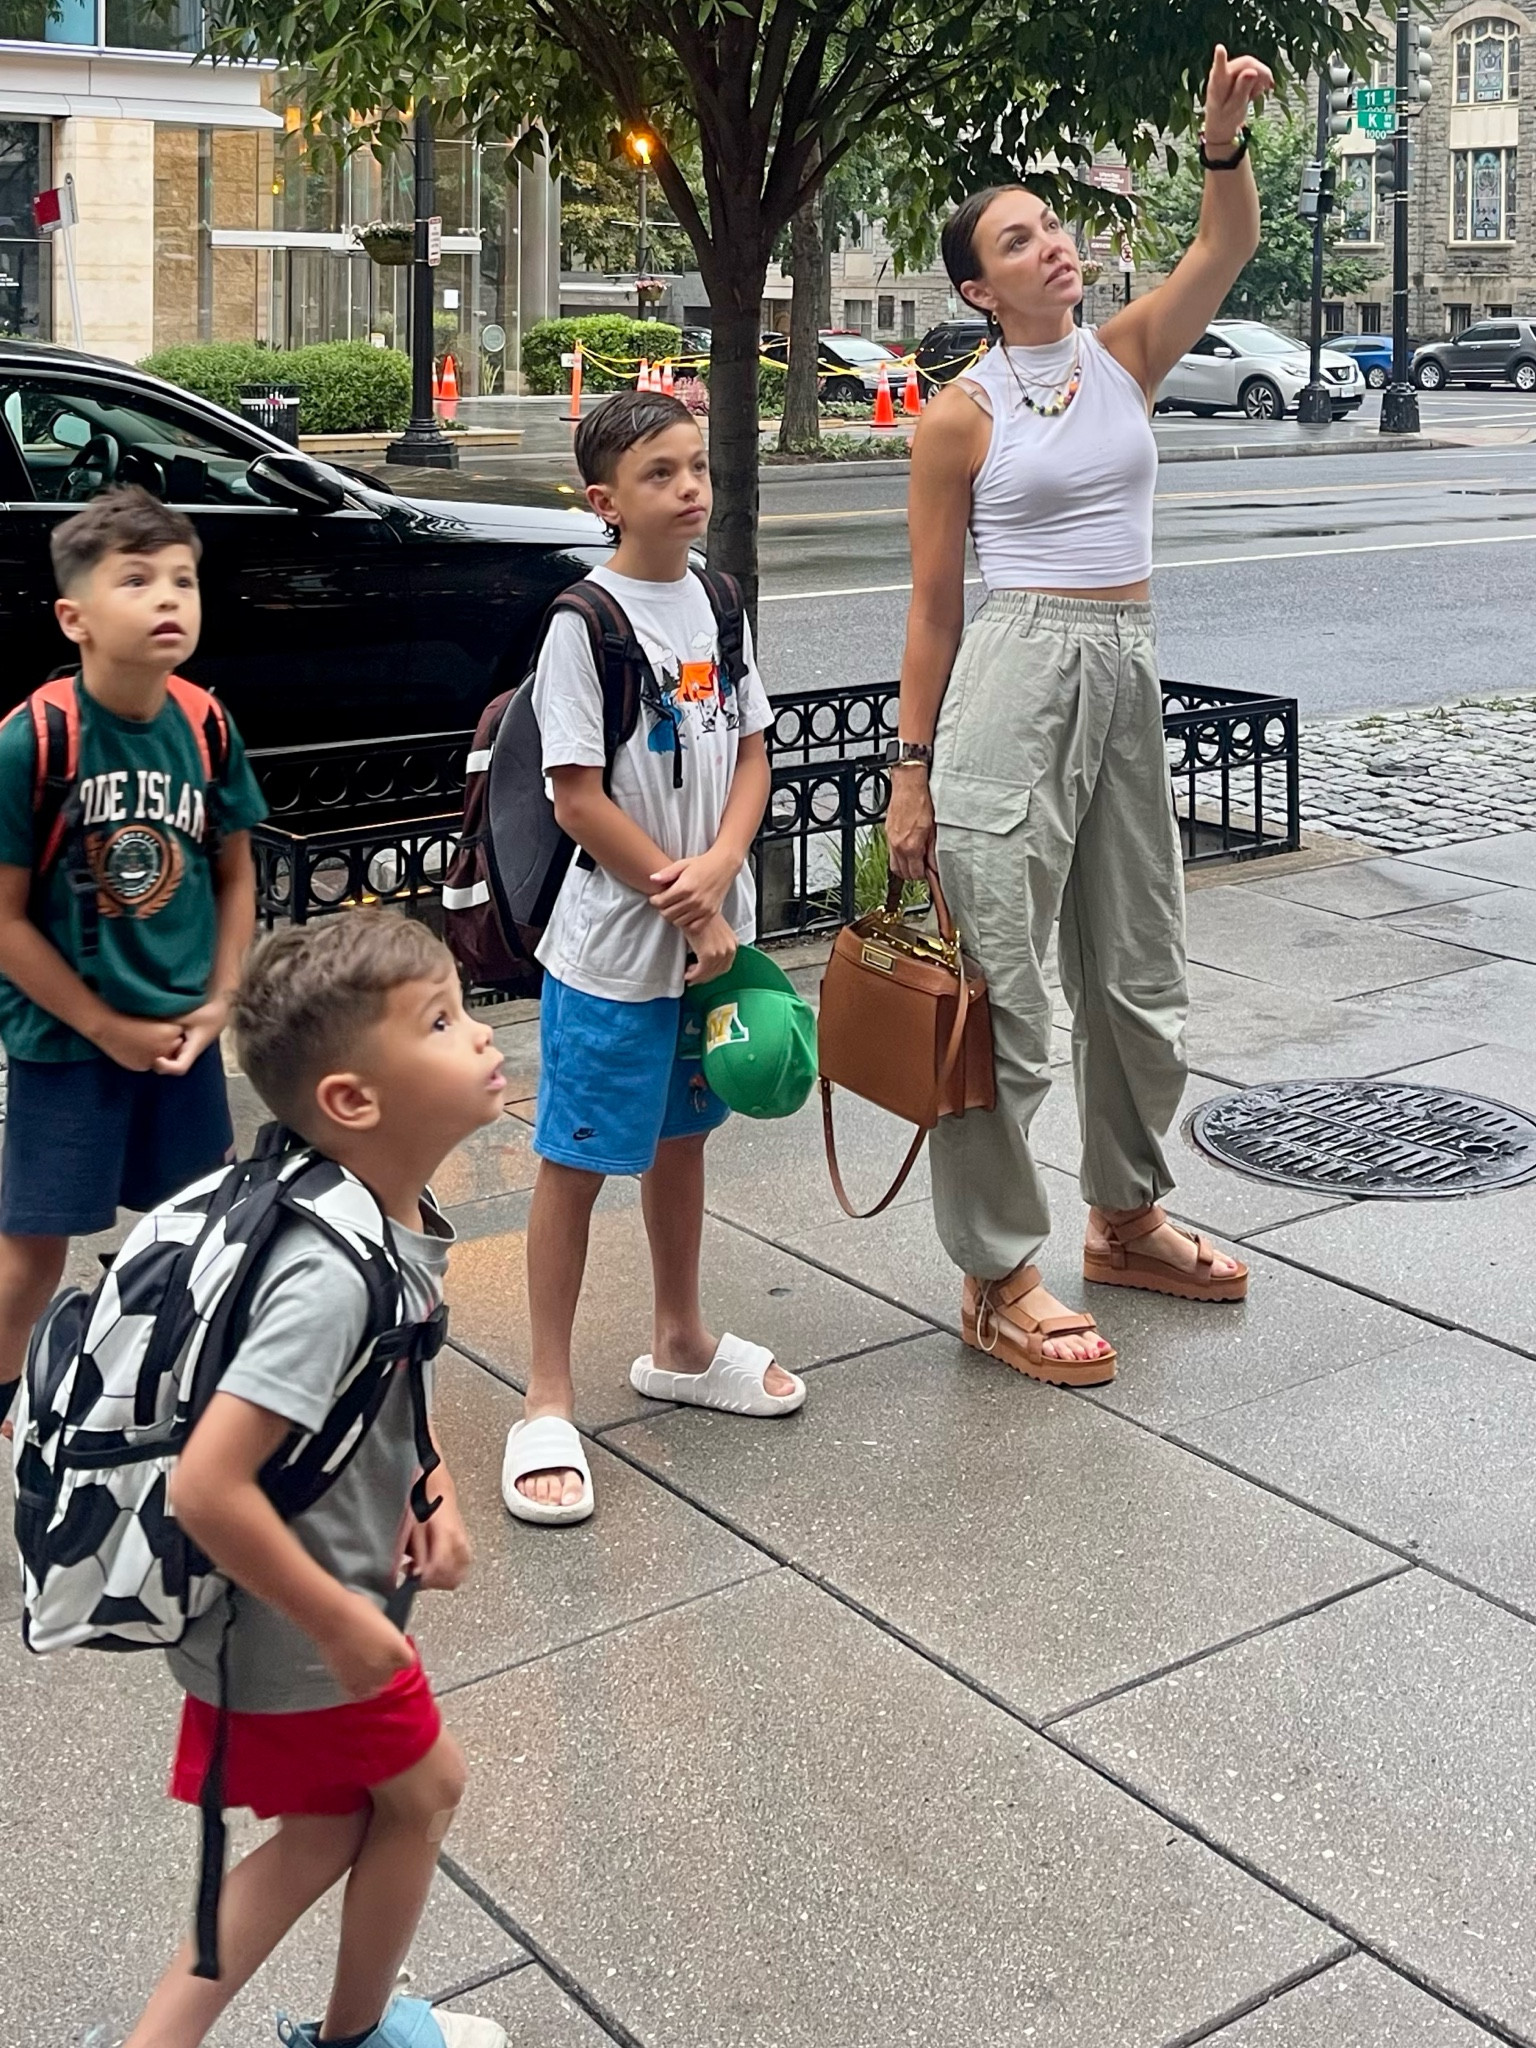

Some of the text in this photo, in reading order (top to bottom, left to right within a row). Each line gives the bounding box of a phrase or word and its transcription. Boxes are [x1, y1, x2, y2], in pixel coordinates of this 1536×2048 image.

[1365, 91, 1376, 106] 11
[1368, 113, 1378, 128] K
[1366, 129, 1387, 140] 1000
[134, 770, 206, 844] ISLAN
